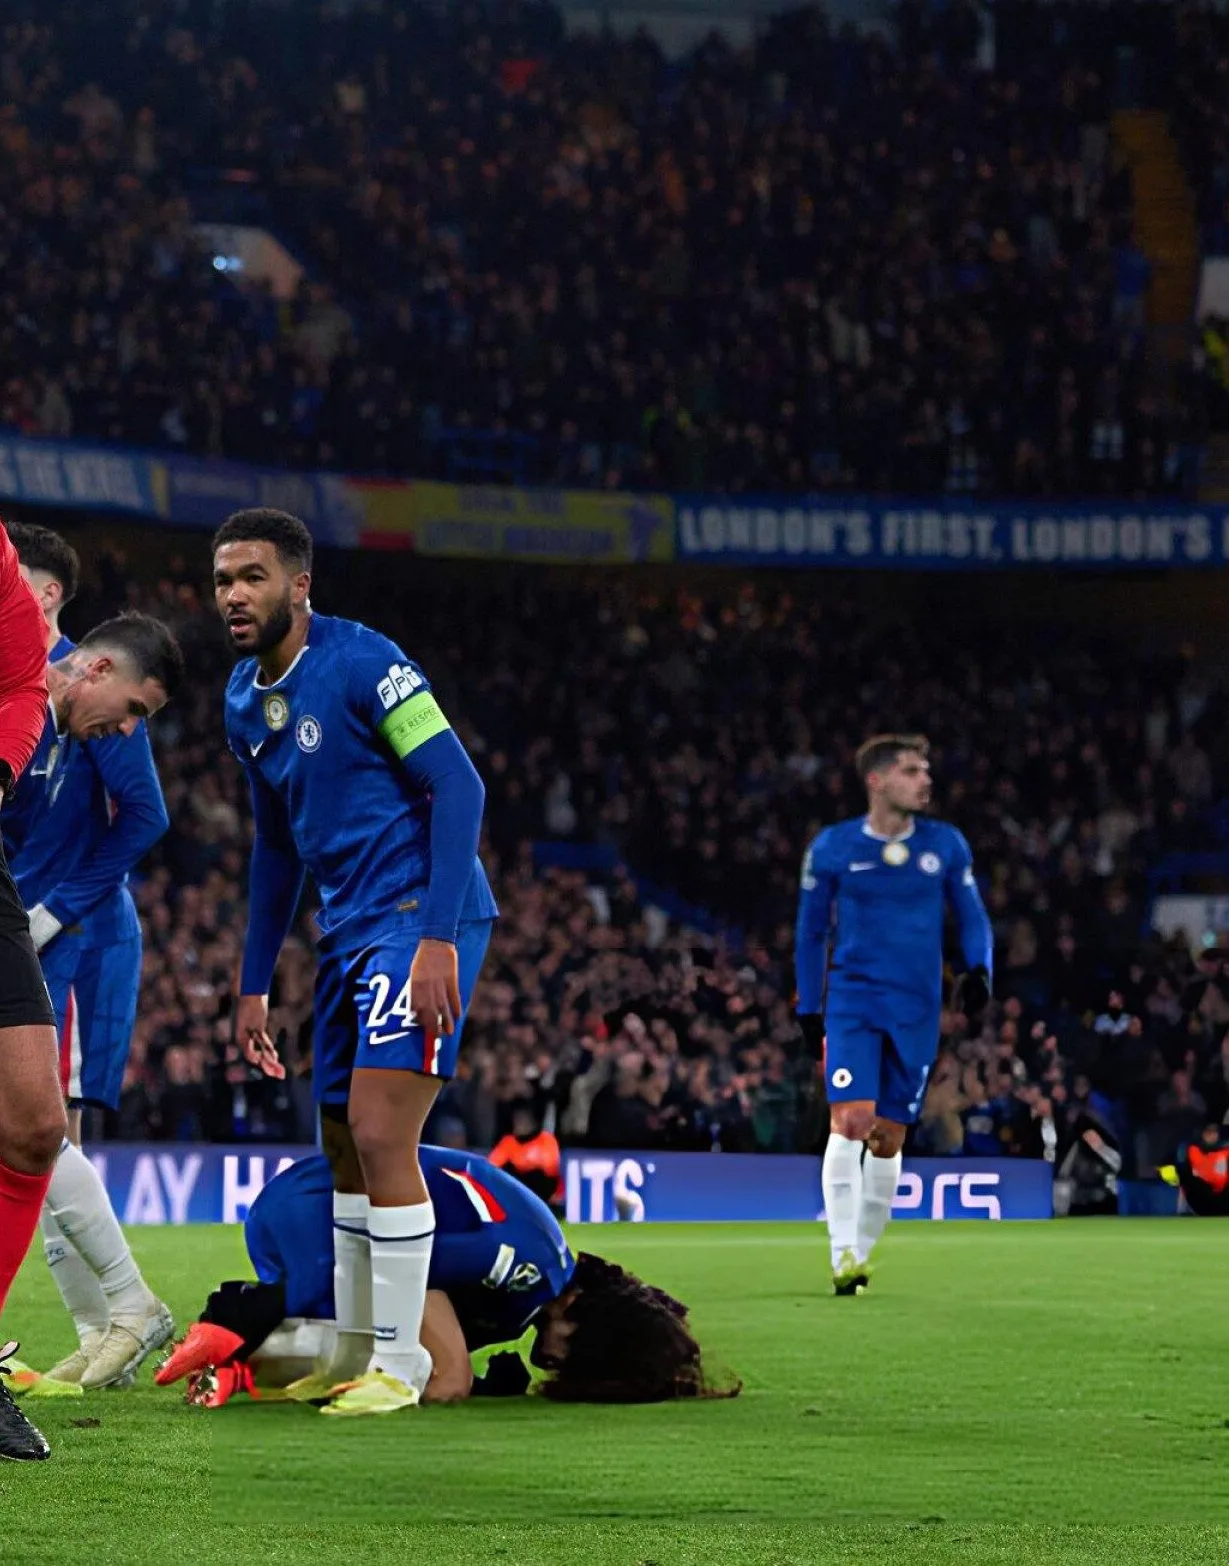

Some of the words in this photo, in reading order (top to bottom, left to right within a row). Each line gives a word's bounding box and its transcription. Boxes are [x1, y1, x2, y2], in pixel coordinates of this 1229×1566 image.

[678, 505, 873, 557] LONDON'S
[1010, 513, 1213, 563] LONDON'S
[379, 668, 419, 704] FPT
[366, 973, 420, 1027] 24
[566, 1158, 645, 1223] ITS
